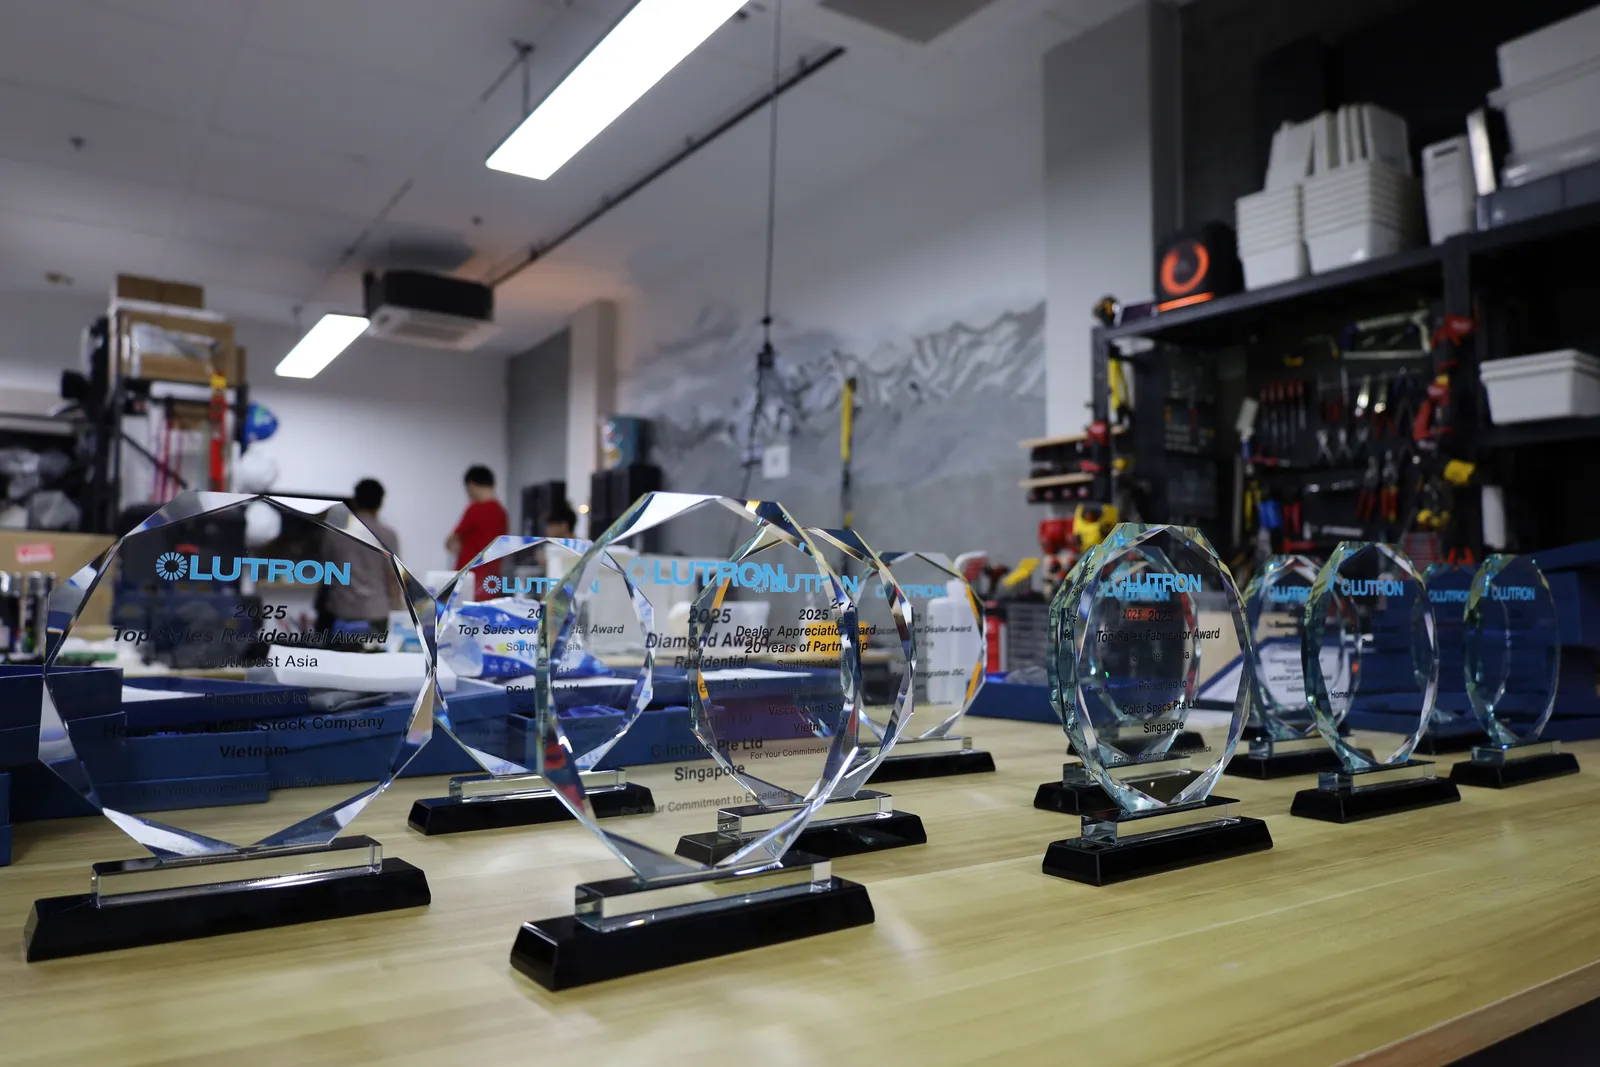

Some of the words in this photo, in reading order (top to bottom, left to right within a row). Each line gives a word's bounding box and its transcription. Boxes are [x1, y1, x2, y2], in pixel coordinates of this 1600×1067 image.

[189, 554, 351, 586] LUTRON
[653, 560, 785, 590] LUTRON
[1127, 573, 1202, 593] LUTRON
[1351, 579, 1405, 597] LUTRON
[1499, 586, 1536, 601] LUTRON
[232, 604, 288, 620] 2025
[688, 608, 732, 623] 2025
[798, 608, 829, 621] 2025
[1122, 608, 1142, 620] 2025
[1148, 610, 1173, 622] 2025
[458, 624, 479, 636] Top
[483, 624, 514, 635] Sales
[591, 624, 624, 635] Award
[736, 625, 774, 638] Dealer
[777, 625, 840, 639] Appreciatio
[950, 622, 973, 632] Award
[113, 627, 151, 645] Top
[158, 627, 214, 643] Sales
[221, 627, 327, 644] Residential
[331, 629, 388, 644] Award
[645, 632, 718, 648] Diamond
[1096, 630, 1115, 643] Top
[1117, 629, 1143, 642] Sales
[1193, 627, 1221, 639] Award
[744, 643, 762, 654] 20
[766, 639, 796, 653] Years
[799, 640, 811, 652] of
[285, 655, 318, 668] Asia
[674, 655, 748, 669] Residential
[1138, 680, 1177, 692] Presented
[1180, 679, 1188, 689] to
[768, 704, 797, 716] Visco
[800, 703, 824, 714] Joint
[1122, 704, 1145, 715] Color
[1147, 702, 1172, 715] Specs
[1173, 700, 1186, 710] Pte
[1187, 697, 1200, 709] Ltd
[260, 716, 307, 732] Stock
[312, 715, 385, 731] Company
[793, 721, 834, 733] Vietnam
[1144, 721, 1184, 735] Singapore
[219, 744, 288, 759] Vietnam
[717, 739, 739, 752] Pte
[743, 736, 763, 750] Ltd
[750, 752, 763, 760] For
[765, 750, 781, 759] Your
[783, 747, 828, 758] Commitment
[674, 764, 746, 782] Singapore
[668, 796, 731, 812] Commitment
[733, 794, 743, 804] to
